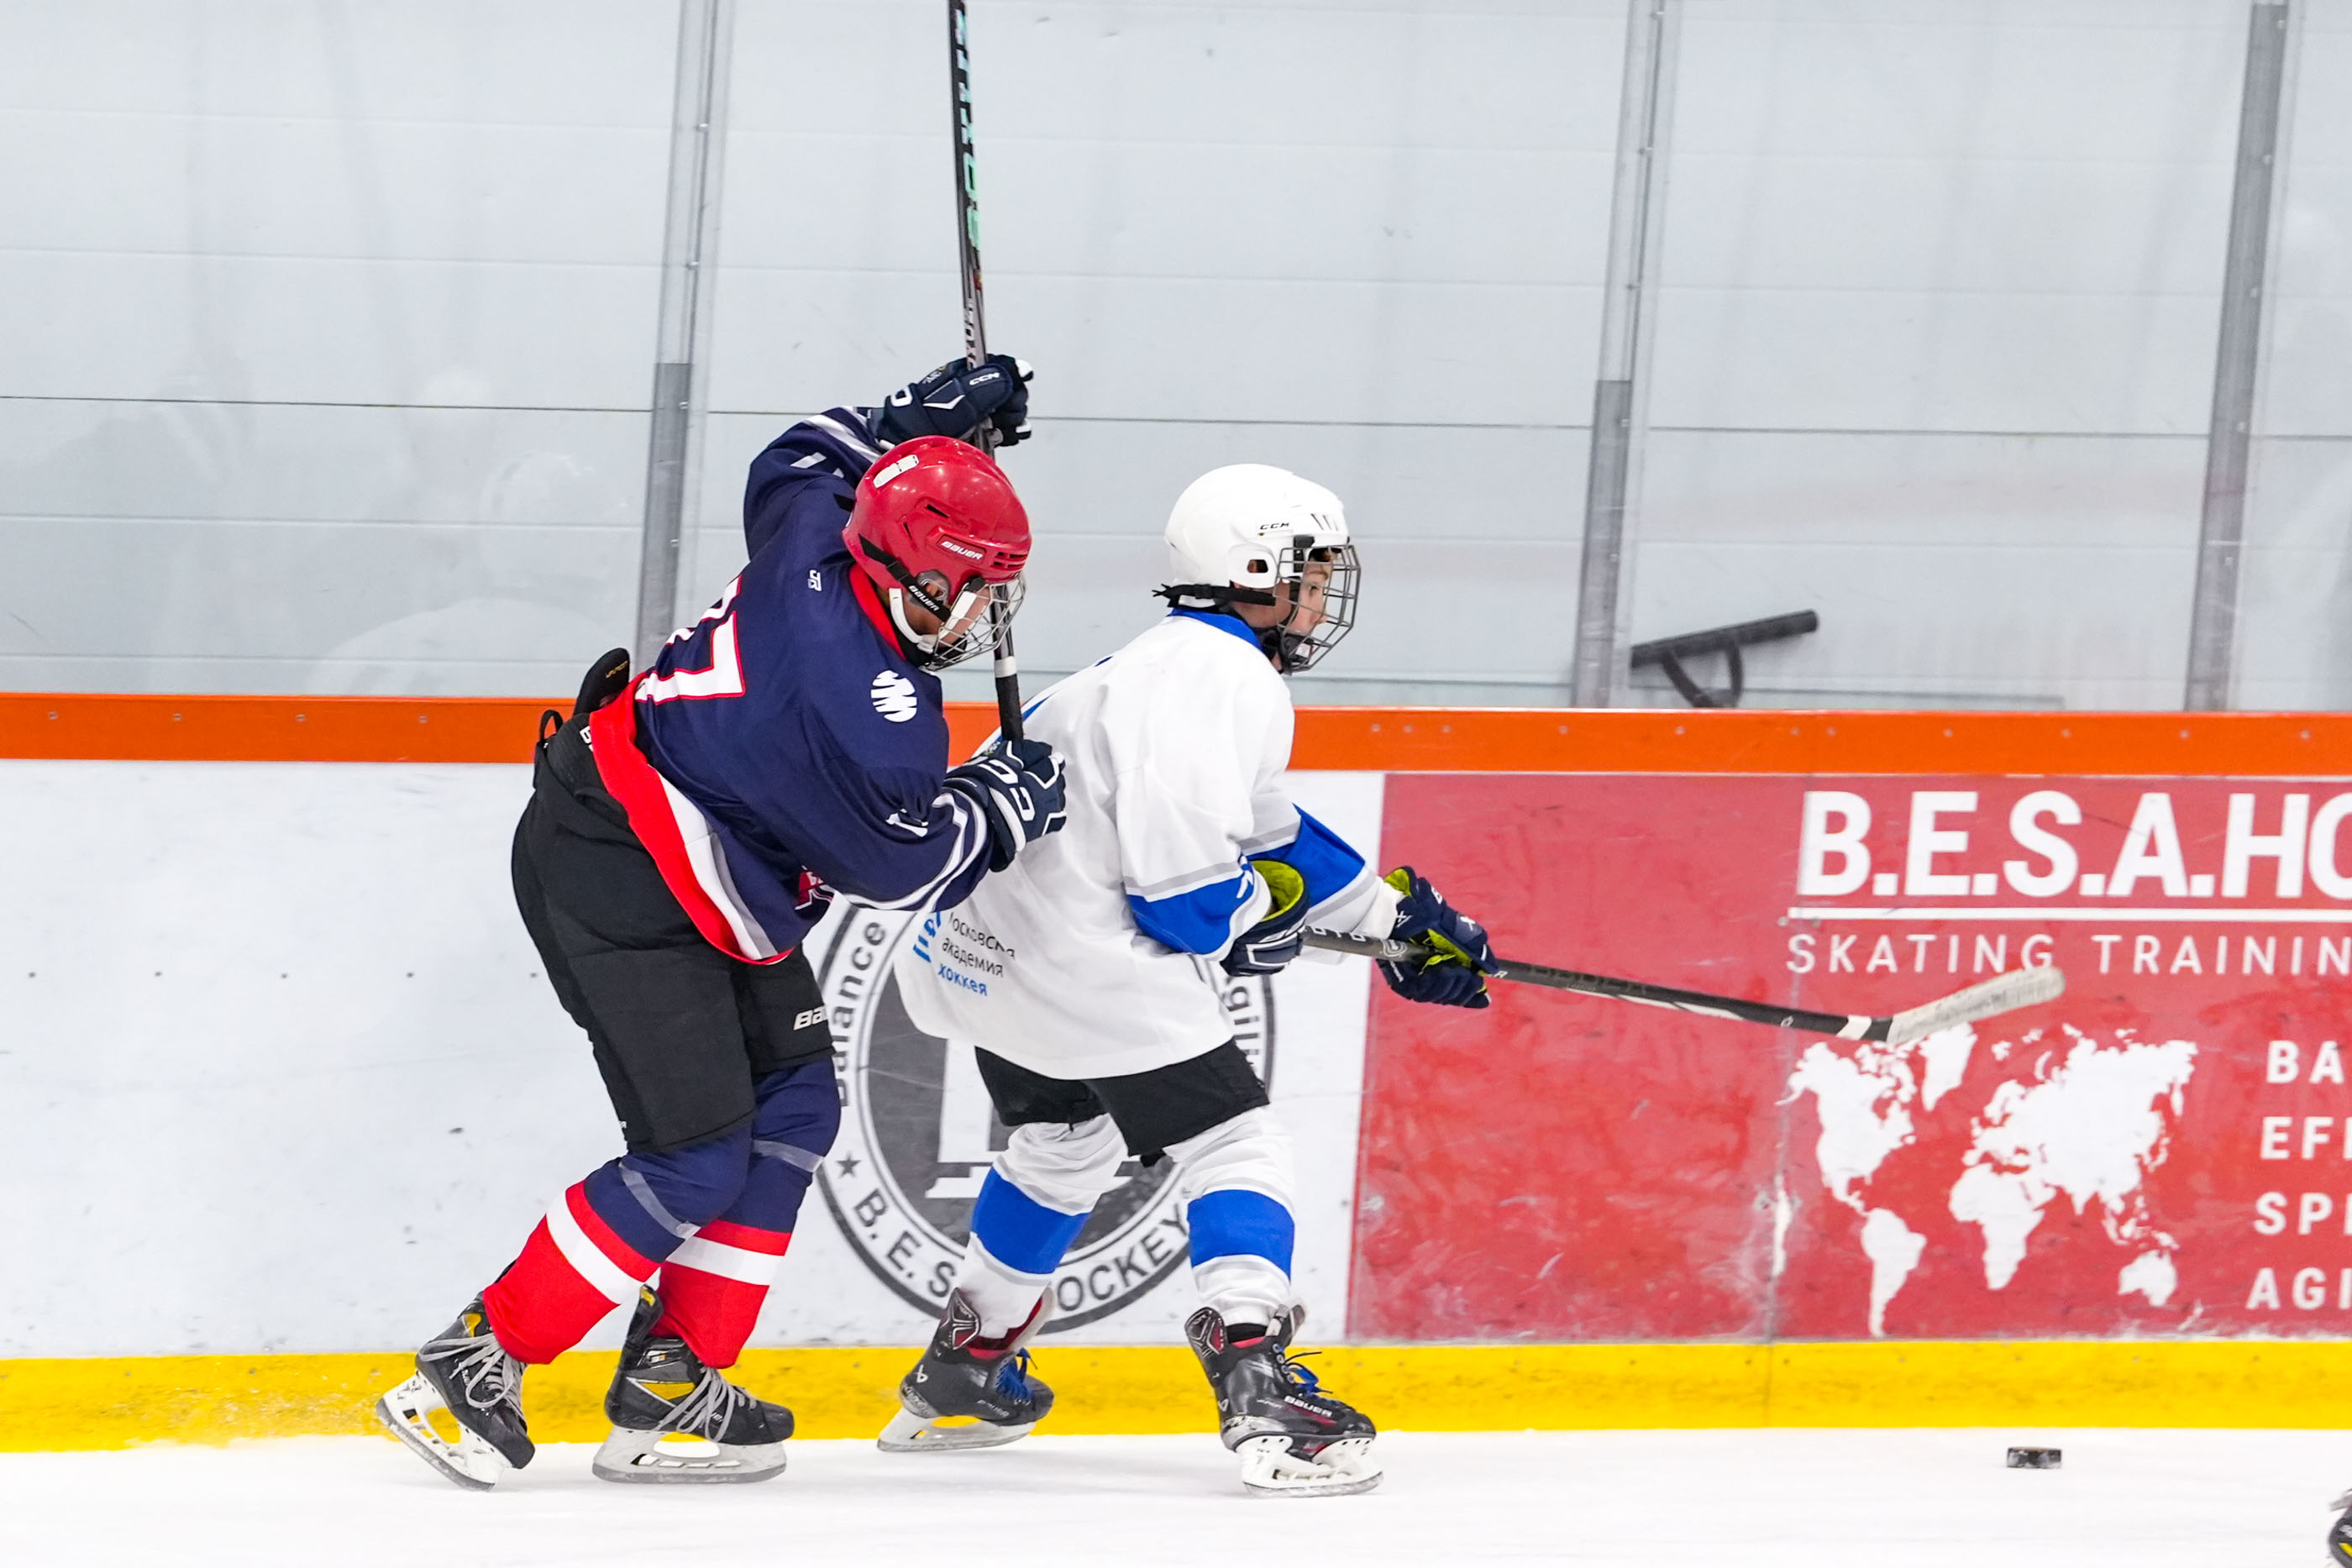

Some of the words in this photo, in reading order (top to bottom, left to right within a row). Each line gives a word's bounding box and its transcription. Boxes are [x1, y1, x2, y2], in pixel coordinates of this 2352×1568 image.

[1260, 522, 1290, 531] CCM
[940, 541, 984, 560] BAUER
[908, 585, 940, 611] BAUER
[1787, 933, 2054, 973] SKATING
[938, 963, 988, 997] хоккея
[1284, 1395, 1333, 1418] BAUER
